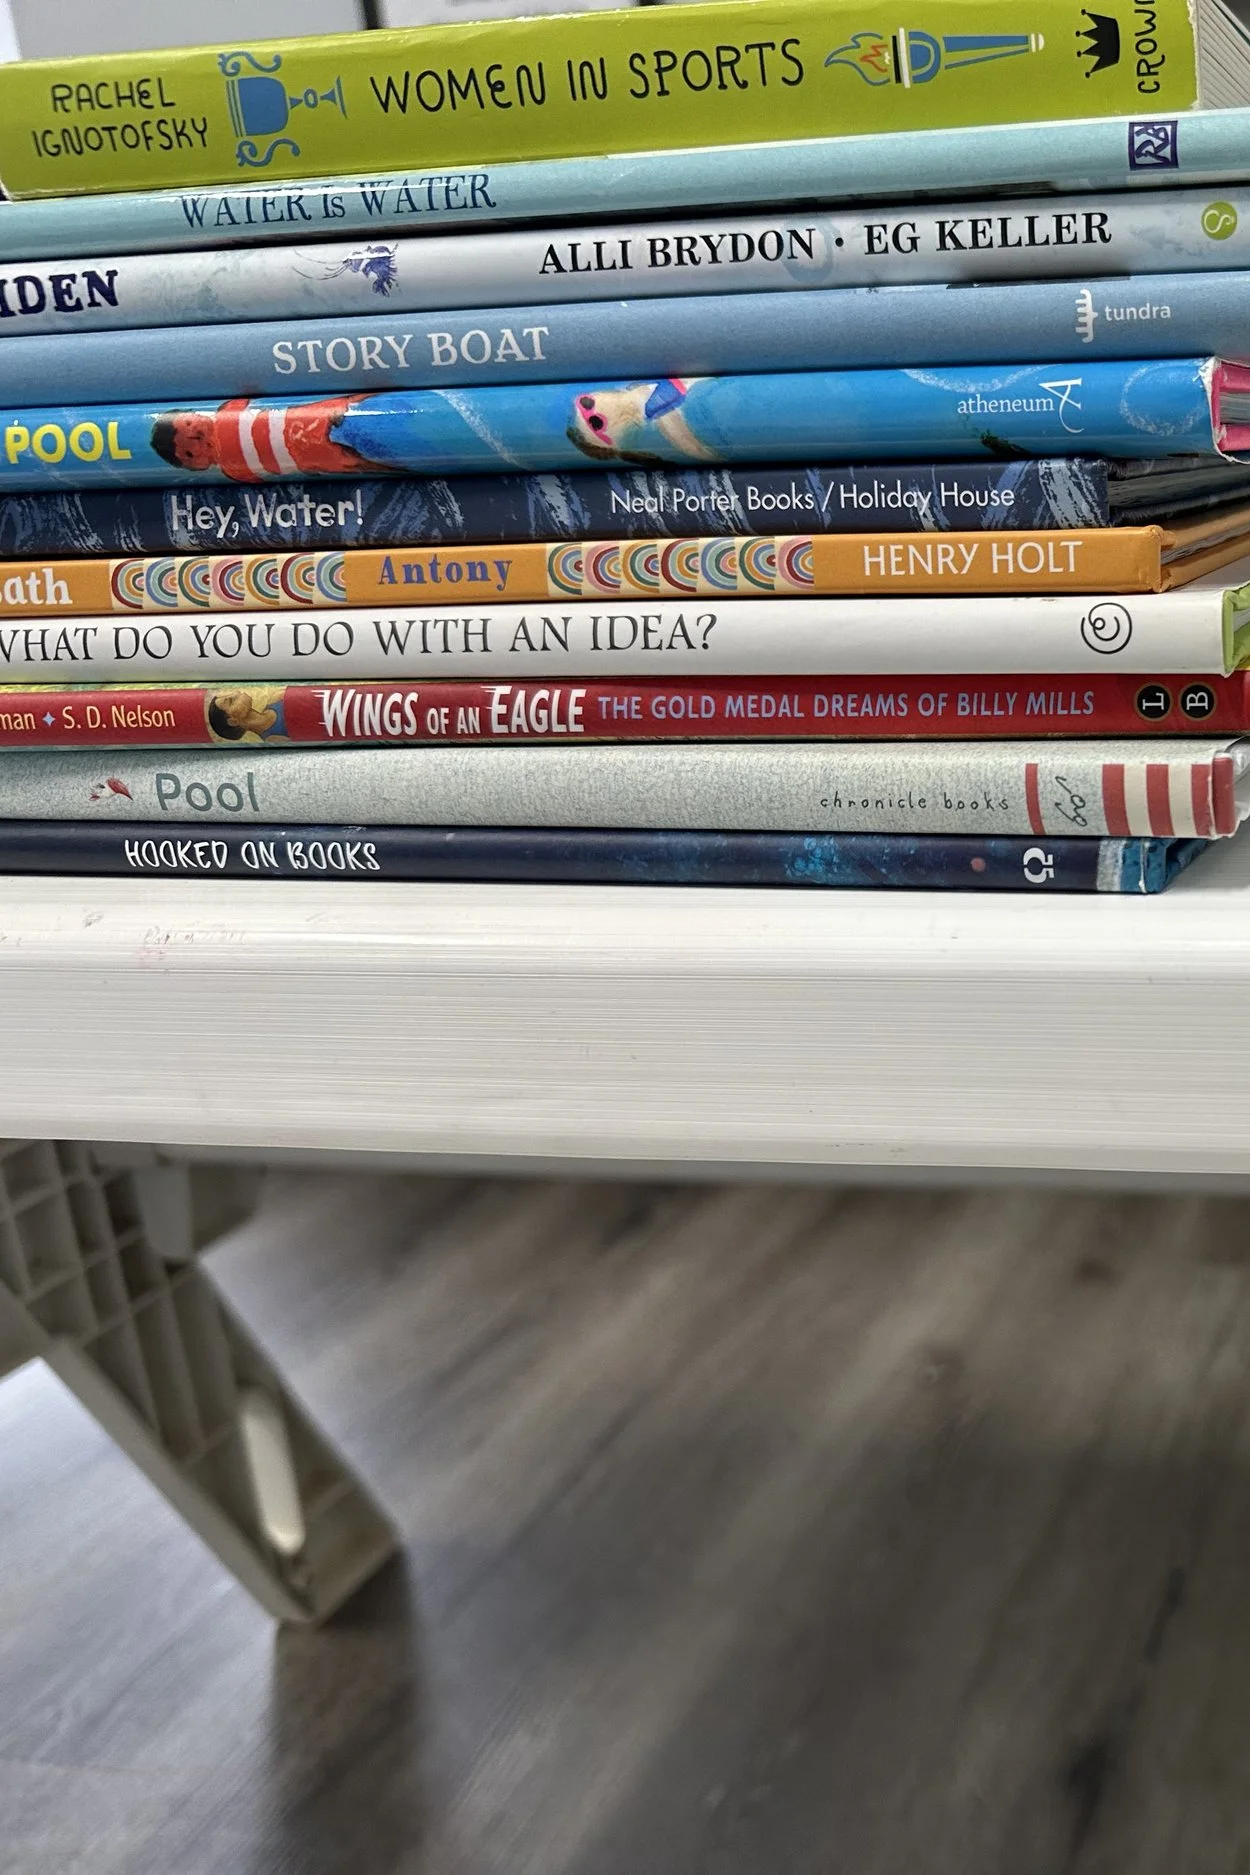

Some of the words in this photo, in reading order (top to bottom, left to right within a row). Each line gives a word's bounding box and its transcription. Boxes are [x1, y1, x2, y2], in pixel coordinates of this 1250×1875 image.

[1134, 0, 1166, 94] CROW
[51, 77, 176, 112] RACHEL
[369, 60, 546, 113] WOMEN
[567, 56, 608, 101] IN
[629, 38, 804, 98] SPORTS
[31, 117, 208, 157] IGNOTOFSKY
[359, 173, 496, 216] WATER
[539, 240, 633, 274] ALLI
[647, 228, 816, 268] BRYDON
[864, 222, 921, 256] EG
[936, 212, 1112, 251] KELLER
[1104, 303, 1171, 320] tundra
[273, 335, 413, 374] STORY
[427, 326, 549, 365] BOAT
[957, 394, 1055, 413] atheneum
[5, 421, 132, 464] POOL
[171, 496, 240, 538] Hey,
[246, 489, 364, 528] Water!
[611, 487, 664, 514] Neal
[673, 486, 739, 511] Porter
[747, 482, 814, 510] Books
[840, 480, 932, 514] Holiday
[940, 482, 1015, 507] House
[378, 553, 514, 591] Antony
[863, 545, 981, 577] HENRY
[991, 540, 1083, 574] HOLT
[0, 567, 73, 606] ath
[113, 625, 172, 660] DO
[190, 622, 274, 658] YOU
[292, 621, 354, 657] DO
[372, 618, 492, 656] WITH
[509, 616, 570, 652] AN
[590, 613, 718, 651] IDEA?
[62, 705, 82, 729] S.
[86, 704, 107, 729] D.
[111, 704, 176, 728] Nelson
[311, 689, 418, 738] WINGS
[427, 705, 450, 734] OF
[457, 705, 481, 734] AN
[481, 685, 587, 734] EAGLE
[599, 695, 643, 720] THE
[651, 694, 715, 720] GOLD
[724, 693, 805, 718] MEDAL
[813, 692, 908, 718] DREAMS
[917, 691, 948, 717] OF
[957, 691, 1017, 717] BILLY
[1024, 690, 1094, 716] MILLS
[155, 771, 260, 812] Pool
[820, 791, 927, 809] chronicle
[943, 791, 1009, 811] books
[123, 840, 228, 869] HOOKED
[241, 841, 280, 869] ON
[286, 842, 381, 871] BOOKS
